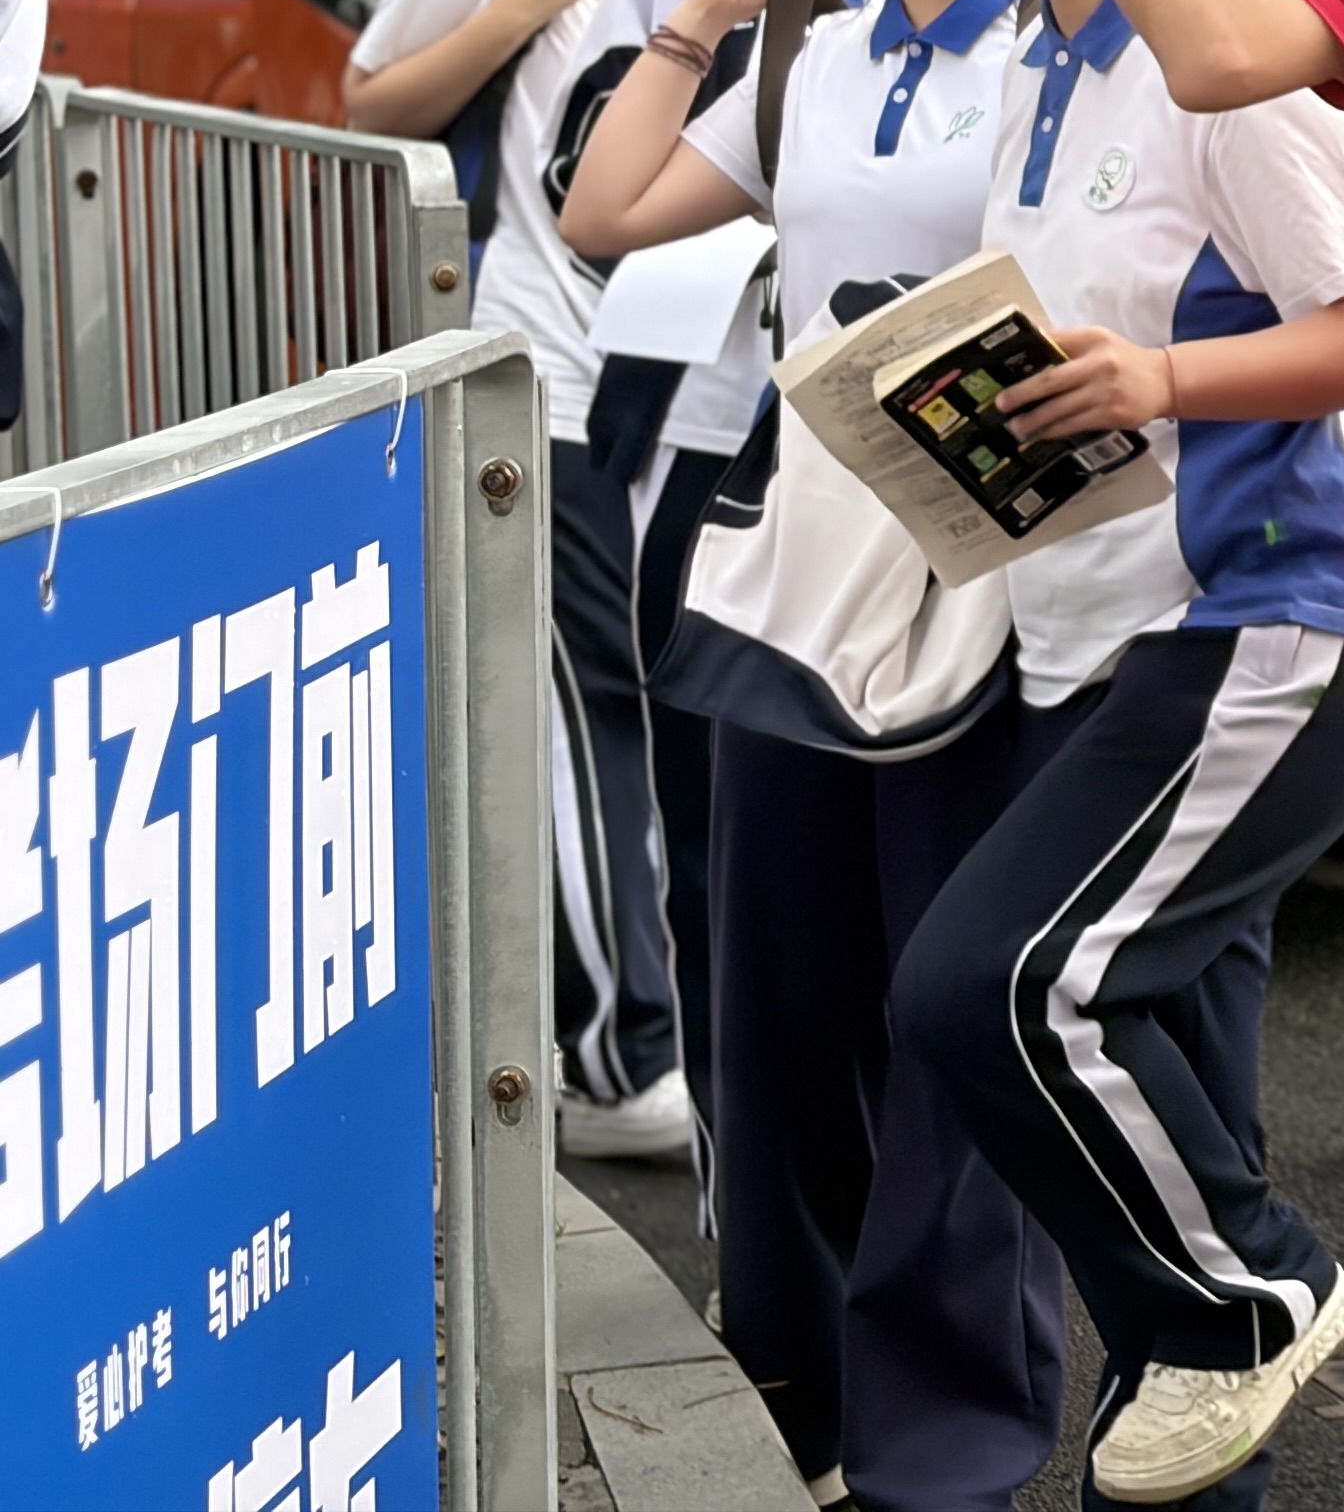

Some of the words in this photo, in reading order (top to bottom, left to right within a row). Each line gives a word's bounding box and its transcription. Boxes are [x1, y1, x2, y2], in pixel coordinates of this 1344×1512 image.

[76, 1305, 172, 1452] 爱心护考
[208, 1209, 291, 1340] 与你同行
